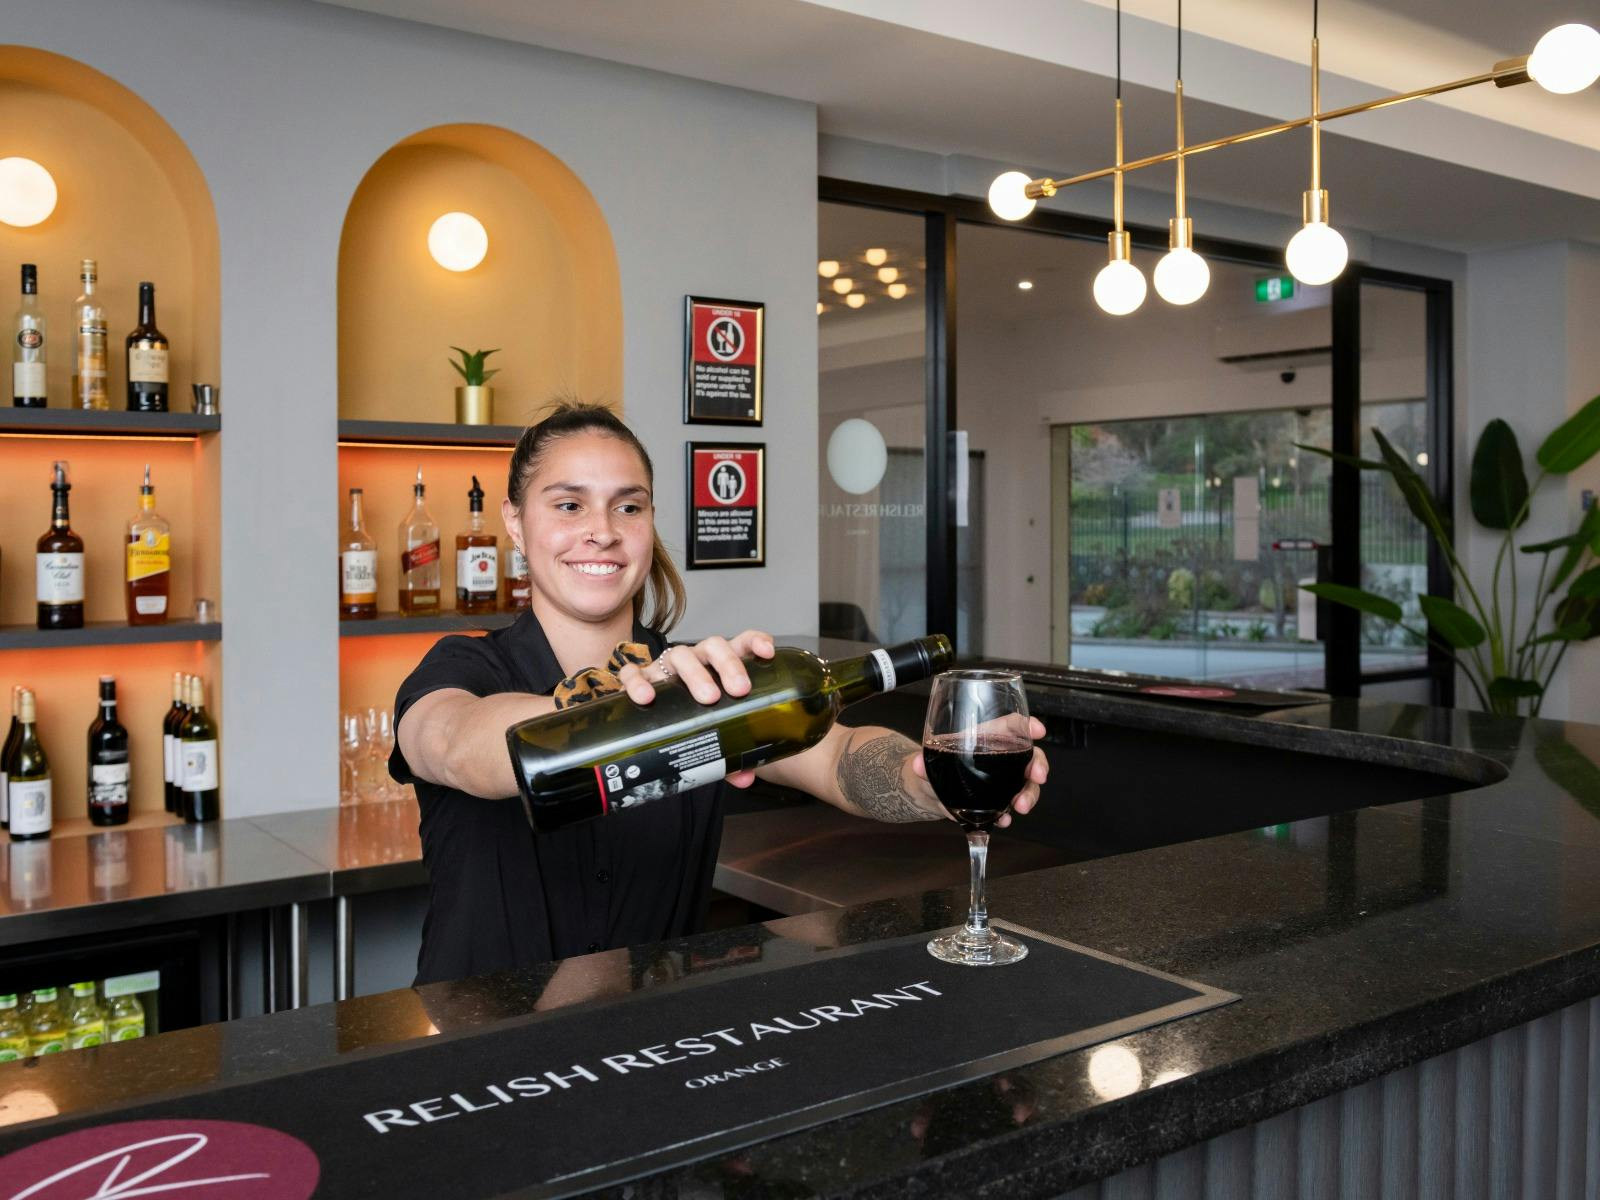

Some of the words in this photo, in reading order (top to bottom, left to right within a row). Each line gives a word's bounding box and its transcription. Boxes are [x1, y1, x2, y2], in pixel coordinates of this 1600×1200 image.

[717, 375, 744, 383] supplied
[695, 382, 719, 390] anyone
[706, 390, 729, 398] against
[739, 518, 752, 526] long
[706, 526, 719, 534] they
[697, 534, 732, 542] responsible
[362, 1064, 599, 1135] RELISH
[601, 981, 944, 1076] RESTAURANT
[684, 1056, 792, 1090] ORANGE
